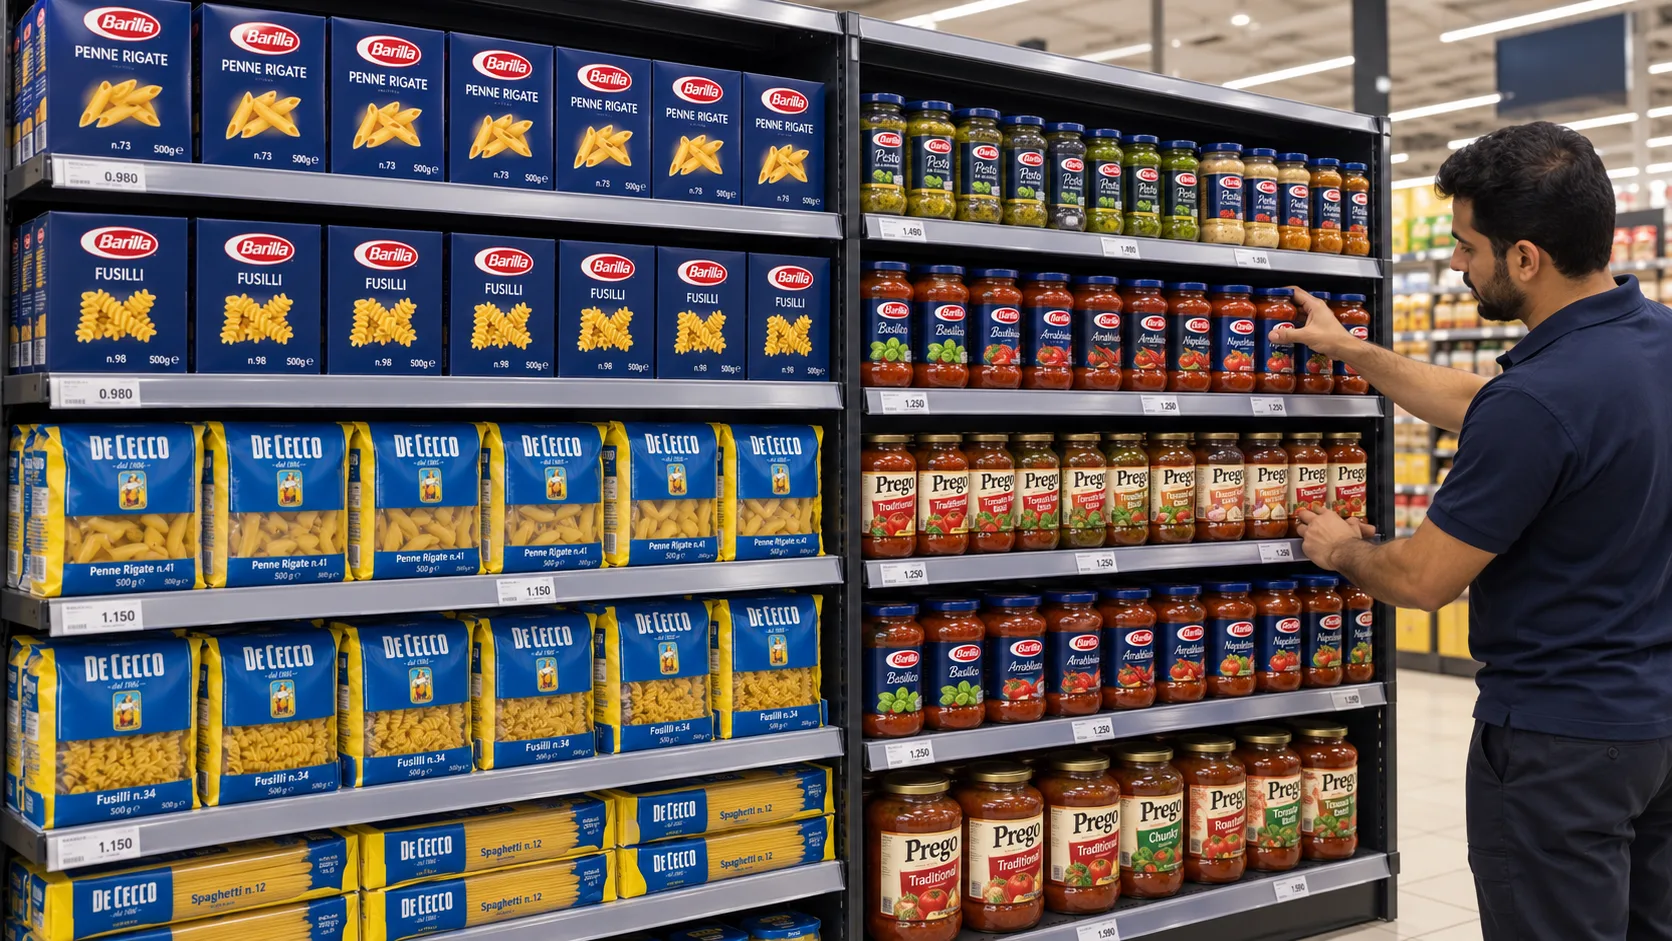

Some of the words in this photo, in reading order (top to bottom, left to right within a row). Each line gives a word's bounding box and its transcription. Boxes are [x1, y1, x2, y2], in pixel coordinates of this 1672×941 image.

[101, 14, 154, 34] Barilla
[246, 29, 293, 48] Barilla
[75, 45, 119, 62] PENNE
[122, 51, 168, 66] RIGATE
[372, 42, 416, 60] Barilla
[221, 59, 262, 74] PENNE
[265, 64, 307, 79] RIGATE
[486, 56, 528, 73] Barilla
[349, 71, 386, 86] PENNE
[390, 76, 428, 91] RIGATE
[590, 70, 628, 87] Barilla
[466, 84, 500, 98] PENNE
[503, 89, 538, 103] RIGATE
[684, 81, 719, 98] Barilla
[571, 97, 602, 110] PENNE
[605, 101, 638, 114] RIGATE
[772, 93, 804, 109] Barilla
[666, 107, 695, 121] PENNE
[698, 112, 728, 125] RIGATE
[755, 118, 782, 131] PENNE
[785, 122, 813, 134] RIGATE
[111, 141, 131, 151] n.73
[253, 151, 272, 161] n.73
[875, 149, 900, 163] Pesto
[379, 160, 396, 170] n.73
[104, 171, 138, 184] 0.980
[99, 232, 152, 252] Barilla
[241, 238, 289, 257] Barilla
[368, 245, 413, 264] Barilla
[488, 253, 528, 271] Barilla
[95, 267, 144, 282] FUSILLI
[593, 260, 631, 276] Barilla
[688, 265, 723, 281] Barilla
[238, 272, 282, 287] FUSILLI
[365, 277, 407, 291] FUSILLI
[778, 271, 810, 286] Barilla
[485, 283, 523, 296] FUSILLI
[590, 288, 625, 301] FUSILLI
[686, 293, 719, 305] FUSILLI
[775, 297, 805, 309] FUSILLI
[877, 321, 908, 335] Basilico
[106, 354, 127, 364] n.98
[248, 356, 267, 366] n.98
[99, 388, 133, 401] 0.980
[905, 399, 924, 408] 1.250
[1160, 402, 1176, 411] 1.250
[90, 436, 113, 460] DE
[116, 434, 169, 459] CECCO
[251, 435, 271, 459] DE
[274, 435, 323, 459] CECCO
[394, 435, 414, 458] DE
[416, 436, 459, 457] CECCO
[521, 435, 538, 456] DE
[541, 436, 582, 457] CECCO
[645, 433, 661, 454] DE
[663, 435, 699, 455] CECCO
[750, 436, 766, 455] DE
[768, 436, 802, 455] CECCO
[875, 476, 914, 496] Prego
[932, 475, 968, 495] Prego
[981, 473, 1014, 492] Prego
[1025, 472, 1059, 490] Prego
[396, 554, 420, 563] Penne
[423, 551, 447, 563] Rigate
[1276, 548, 1290, 557] 1.250
[90, 565, 121, 576] Penne
[123, 563, 154, 577] Rigate
[156, 563, 175, 573] n.41
[252, 560, 279, 570] Penne
[282, 559, 309, 571] Rigate
[1096, 558, 1113, 568] 1.250
[904, 569, 923, 579] 1.250
[526, 586, 550, 596] 1.150
[101, 610, 135, 623] 1.150
[635, 613, 653, 635] DE
[654, 612, 691, 633] CECCO
[746, 607, 763, 627] DE
[765, 605, 800, 626] CECCO
[383, 634, 402, 659] DE
[404, 633, 449, 656] CECCO
[512, 627, 529, 649] DE
[531, 626, 573, 647] CECCO
[243, 647, 264, 671] DE
[266, 644, 314, 669] CECCO
[85, 656, 108, 682] DE
[111, 652, 165, 679] CECCO
[1093, 725, 1110, 735] 1.250
[397, 756, 424, 768] Fusilli
[427, 754, 445, 764] n.34
[910, 748, 930, 759] 1.250
[255, 773, 286, 787] Fusilli
[288, 772, 309, 783] n.34
[97, 791, 131, 805] Fusilli
[133, 788, 156, 801] n.34
[653, 803, 665, 823] DE
[667, 800, 696, 820] CECCO
[757, 804, 773, 814] n.12
[1140, 799, 1182, 822] Prego
[1073, 809, 1119, 834] Prego
[993, 822, 1040, 849] Prego
[1149, 827, 1178, 844] Chunky
[98, 838, 132, 853] 1.150
[401, 838, 417, 861] DE
[420, 836, 452, 858] CECCO
[481, 844, 521, 862] Spaghetti
[525, 839, 542, 851] n.12
[904, 836, 958, 863] Prego
[1077, 838, 1118, 857] Traditional
[654, 853, 665, 873] DE
[668, 849, 696, 870] CECCO
[757, 851, 773, 861] n.12
[997, 849, 1039, 872] Traditional
[909, 864, 956, 887] Traditional
[92, 889, 111, 912] DE
[114, 882, 157, 907] CECCO
[191, 885, 243, 905] Spaghetti
[245, 882, 266, 895] n.12
[402, 895, 418, 918] DE
[420, 892, 453, 915] CECCO
[481, 896, 522, 915] Spaghetti
[525, 893, 542, 904] n.12
